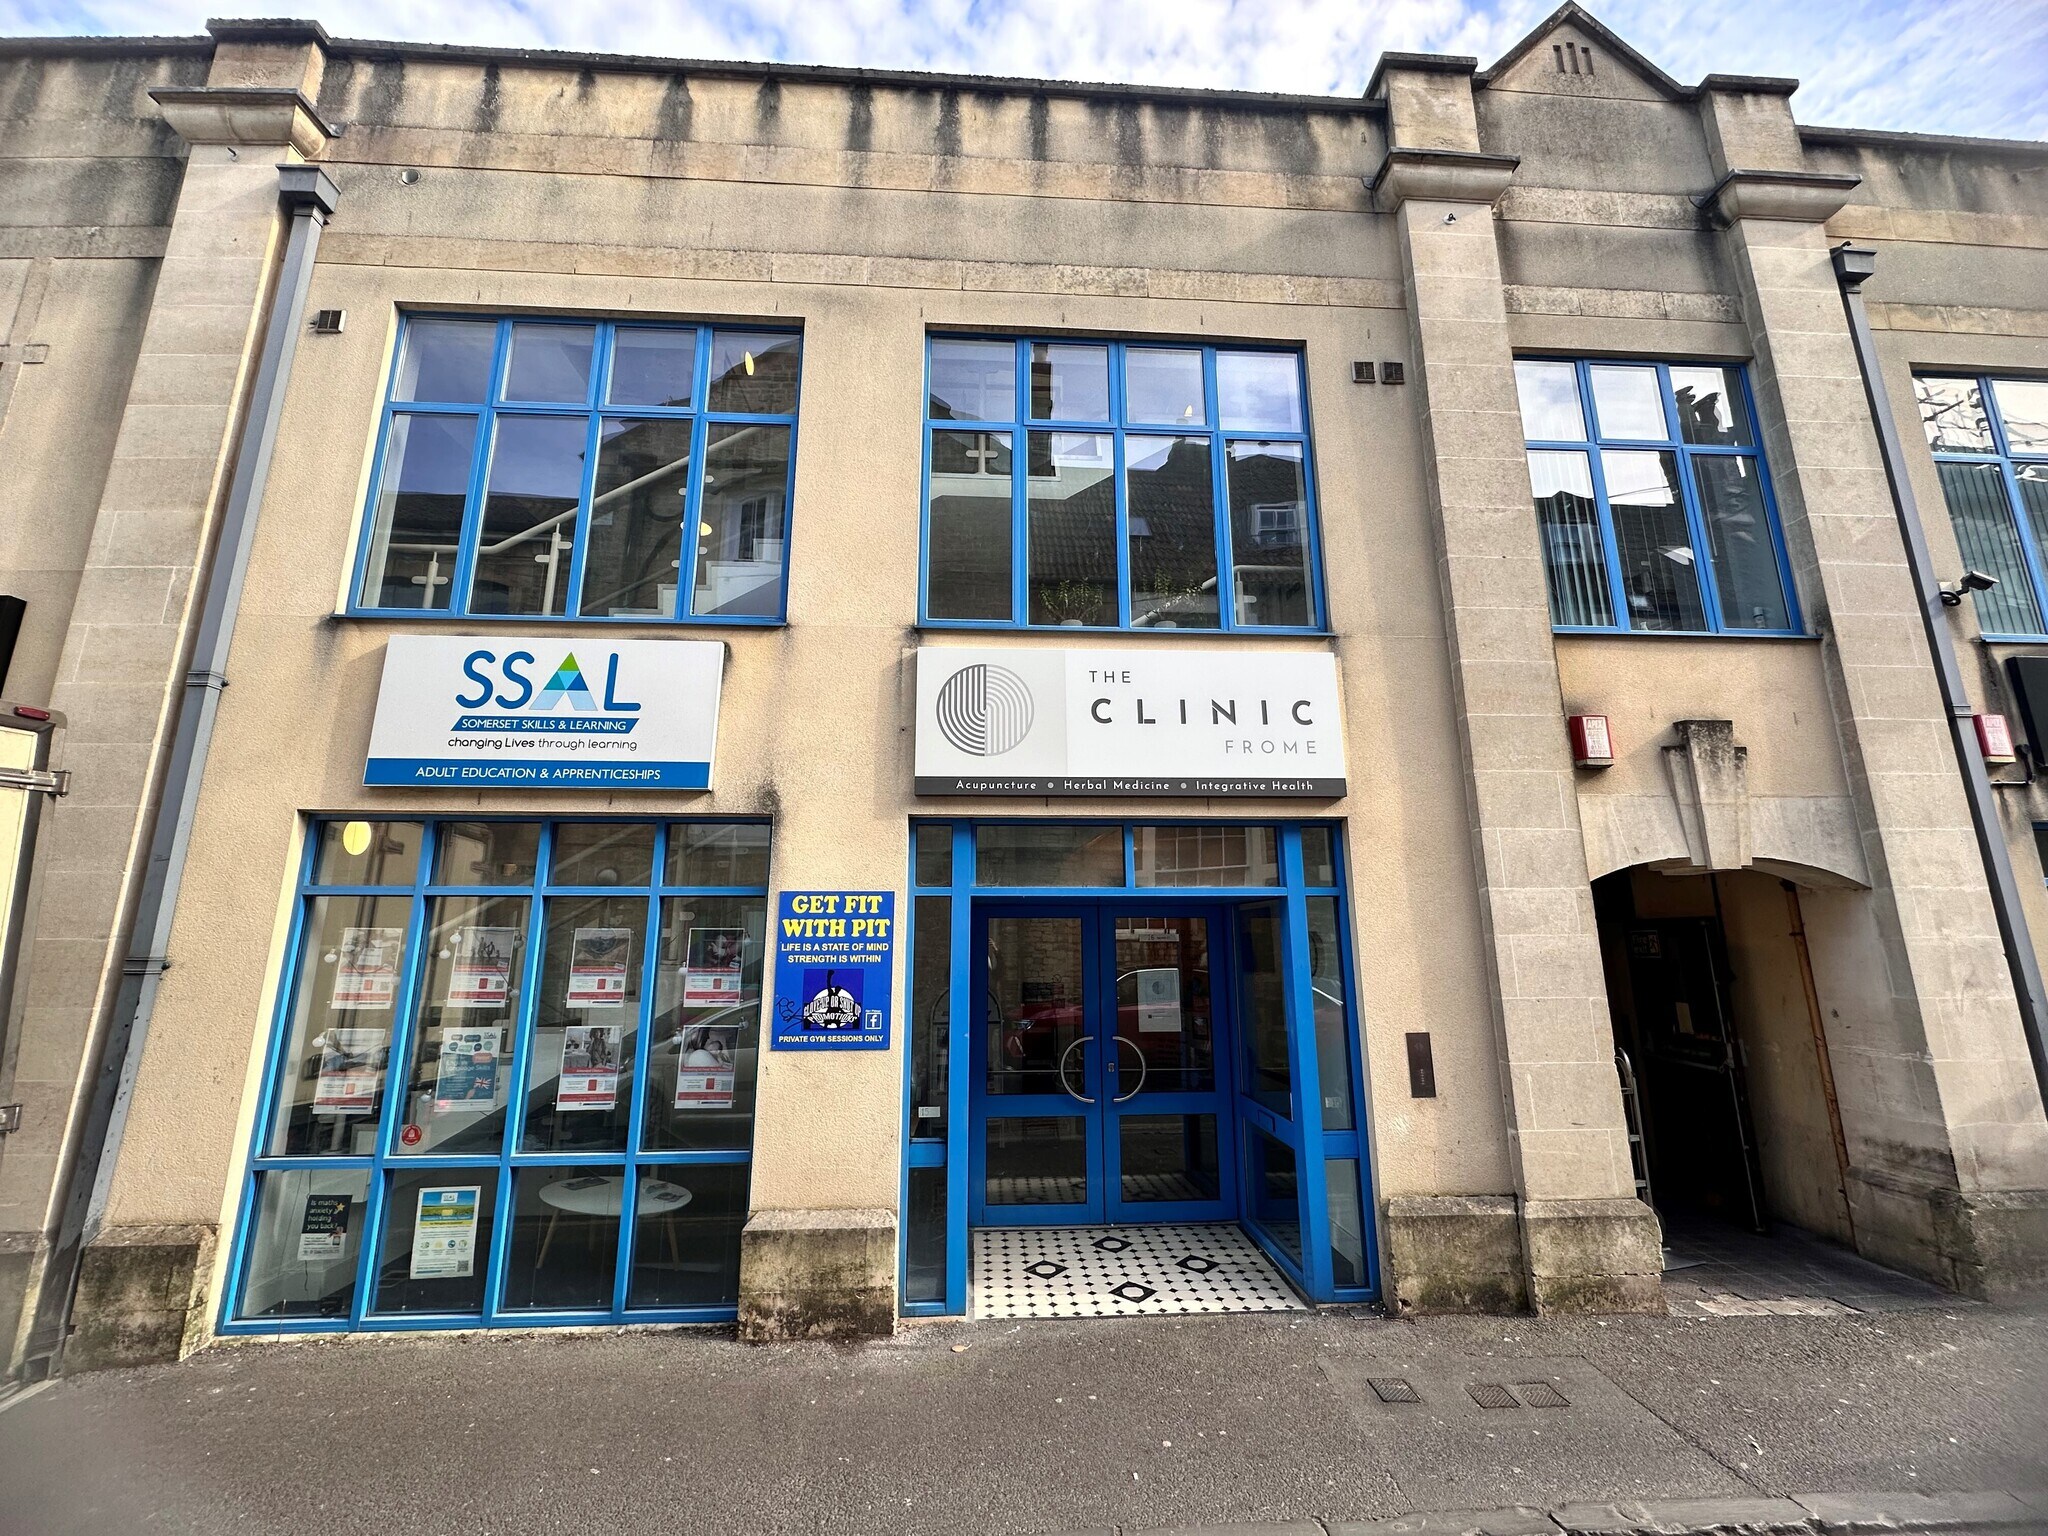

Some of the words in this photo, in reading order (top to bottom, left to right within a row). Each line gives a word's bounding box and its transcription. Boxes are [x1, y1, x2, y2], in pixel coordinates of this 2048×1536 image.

[455, 650, 642, 711] SSAL
[1089, 670, 1132, 684] THE
[1090, 698, 1314, 726] CLINIC
[461, 719, 520, 729] SOMERSET
[521, 719, 556, 729] SKILLS
[558, 720, 567, 729] &
[569, 720, 627, 731] LEARNING
[447, 737, 503, 750] changing
[504, 738, 535, 748] Lives
[538, 738, 585, 751] through
[587, 739, 638, 752] learning
[1225, 740, 1317, 755] FROME
[415, 767, 459, 777] ADULT
[461, 767, 537, 779] EDUCATION
[539, 768, 549, 779] &
[552, 768, 661, 780] APPRENTICESHIPS
[955, 780, 1037, 791] Acupuncture
[1064, 780, 1107, 790] Herbal
[1113, 780, 1170, 790] Medicine
[1196, 781, 1266, 792] Integrative
[1272, 781, 1313, 790] Health
[792, 895, 840, 914] GET
[843, 895, 883, 914] FIT
[782, 918, 847, 938] WITH
[851, 918, 891, 938] PIT
[781, 943, 801, 952] LIFE
[802, 943, 812, 952] IS
[812, 943, 820, 952] A
[821, 943, 850, 952] STATE
[851, 943, 865, 952] OF
[866, 943, 889, 952] MIND
[788, 954, 837, 963] STRENGTH
[838, 954, 848, 963] IS
[850, 954, 881, 963] WITHIN
